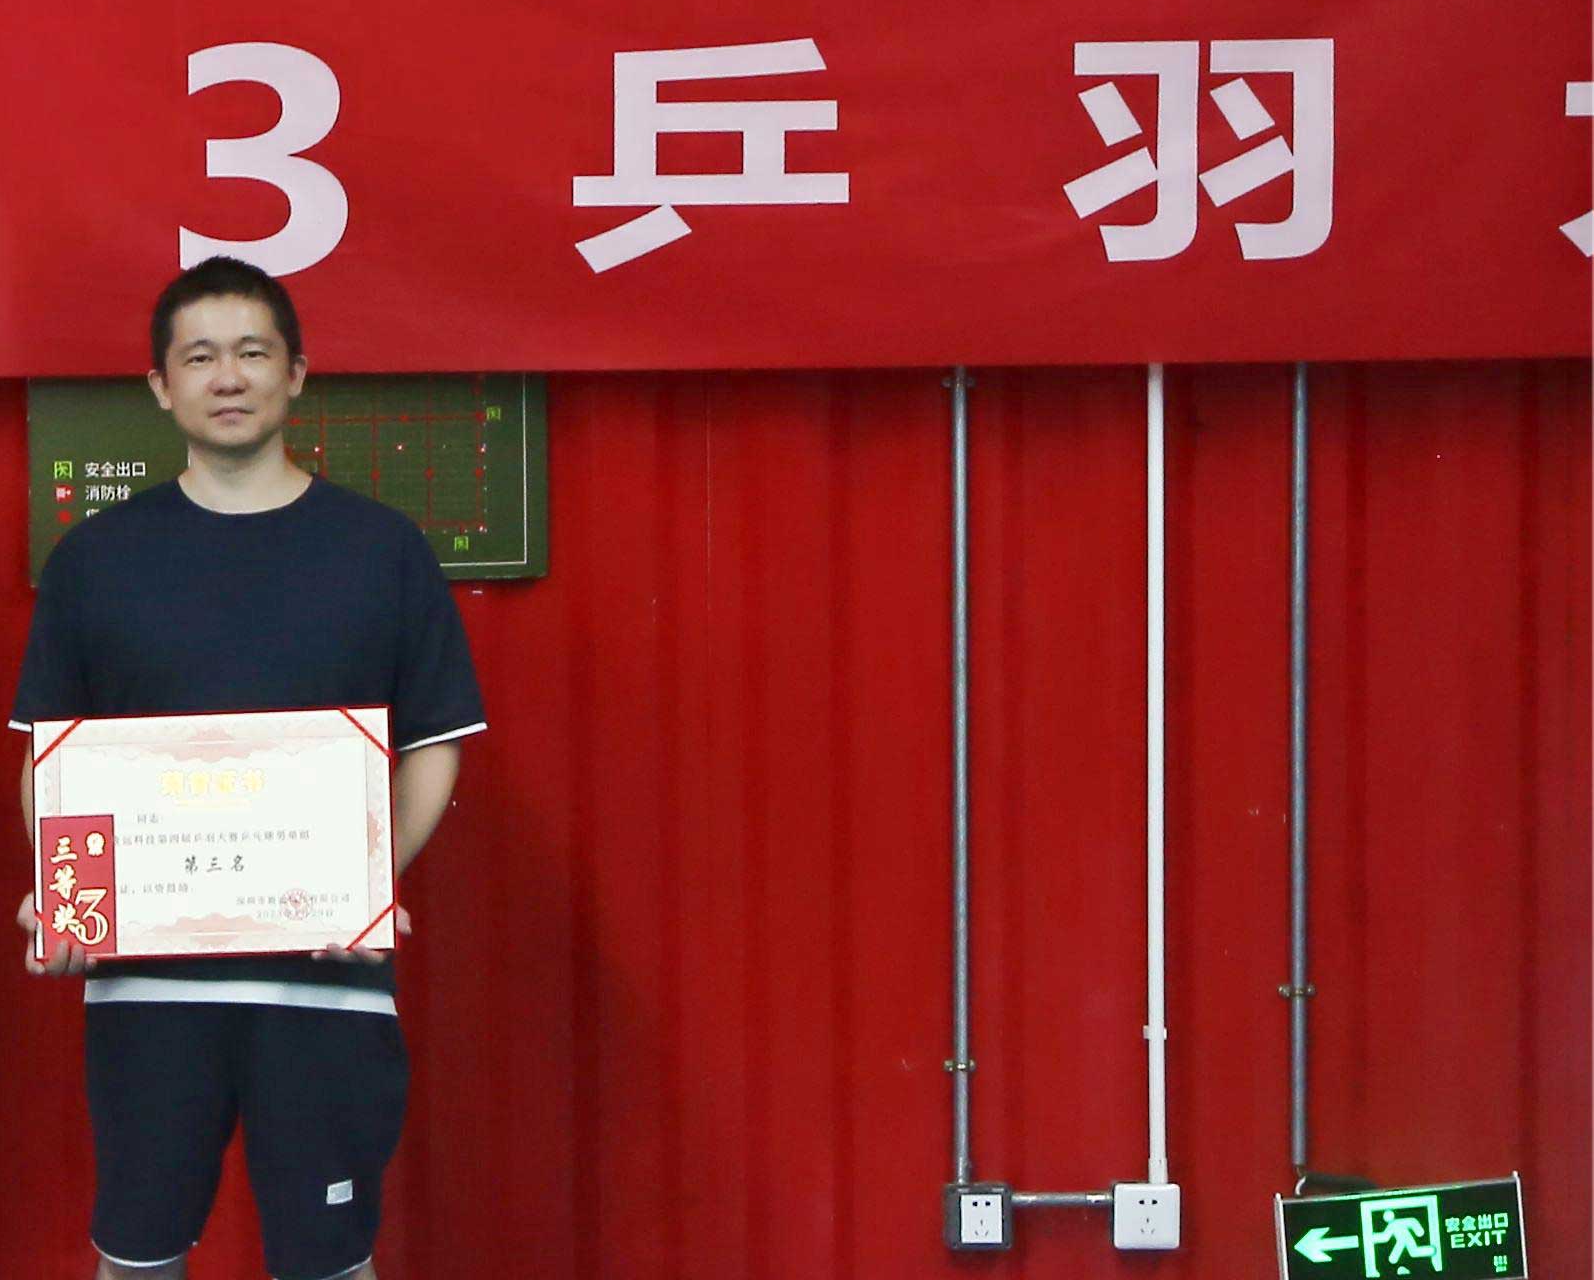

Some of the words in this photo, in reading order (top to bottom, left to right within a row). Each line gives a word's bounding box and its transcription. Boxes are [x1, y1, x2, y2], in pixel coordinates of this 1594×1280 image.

[85, 461, 146, 478] 安全出口
[85, 484, 132, 501] 消防栓
[184, 855, 246, 876] 第三名
[50, 836, 79, 934] 三等奖
[74, 888, 108, 946] 3
[1445, 1213, 1508, 1233] 安全出口
[1450, 1230, 1507, 1249] EXIT
